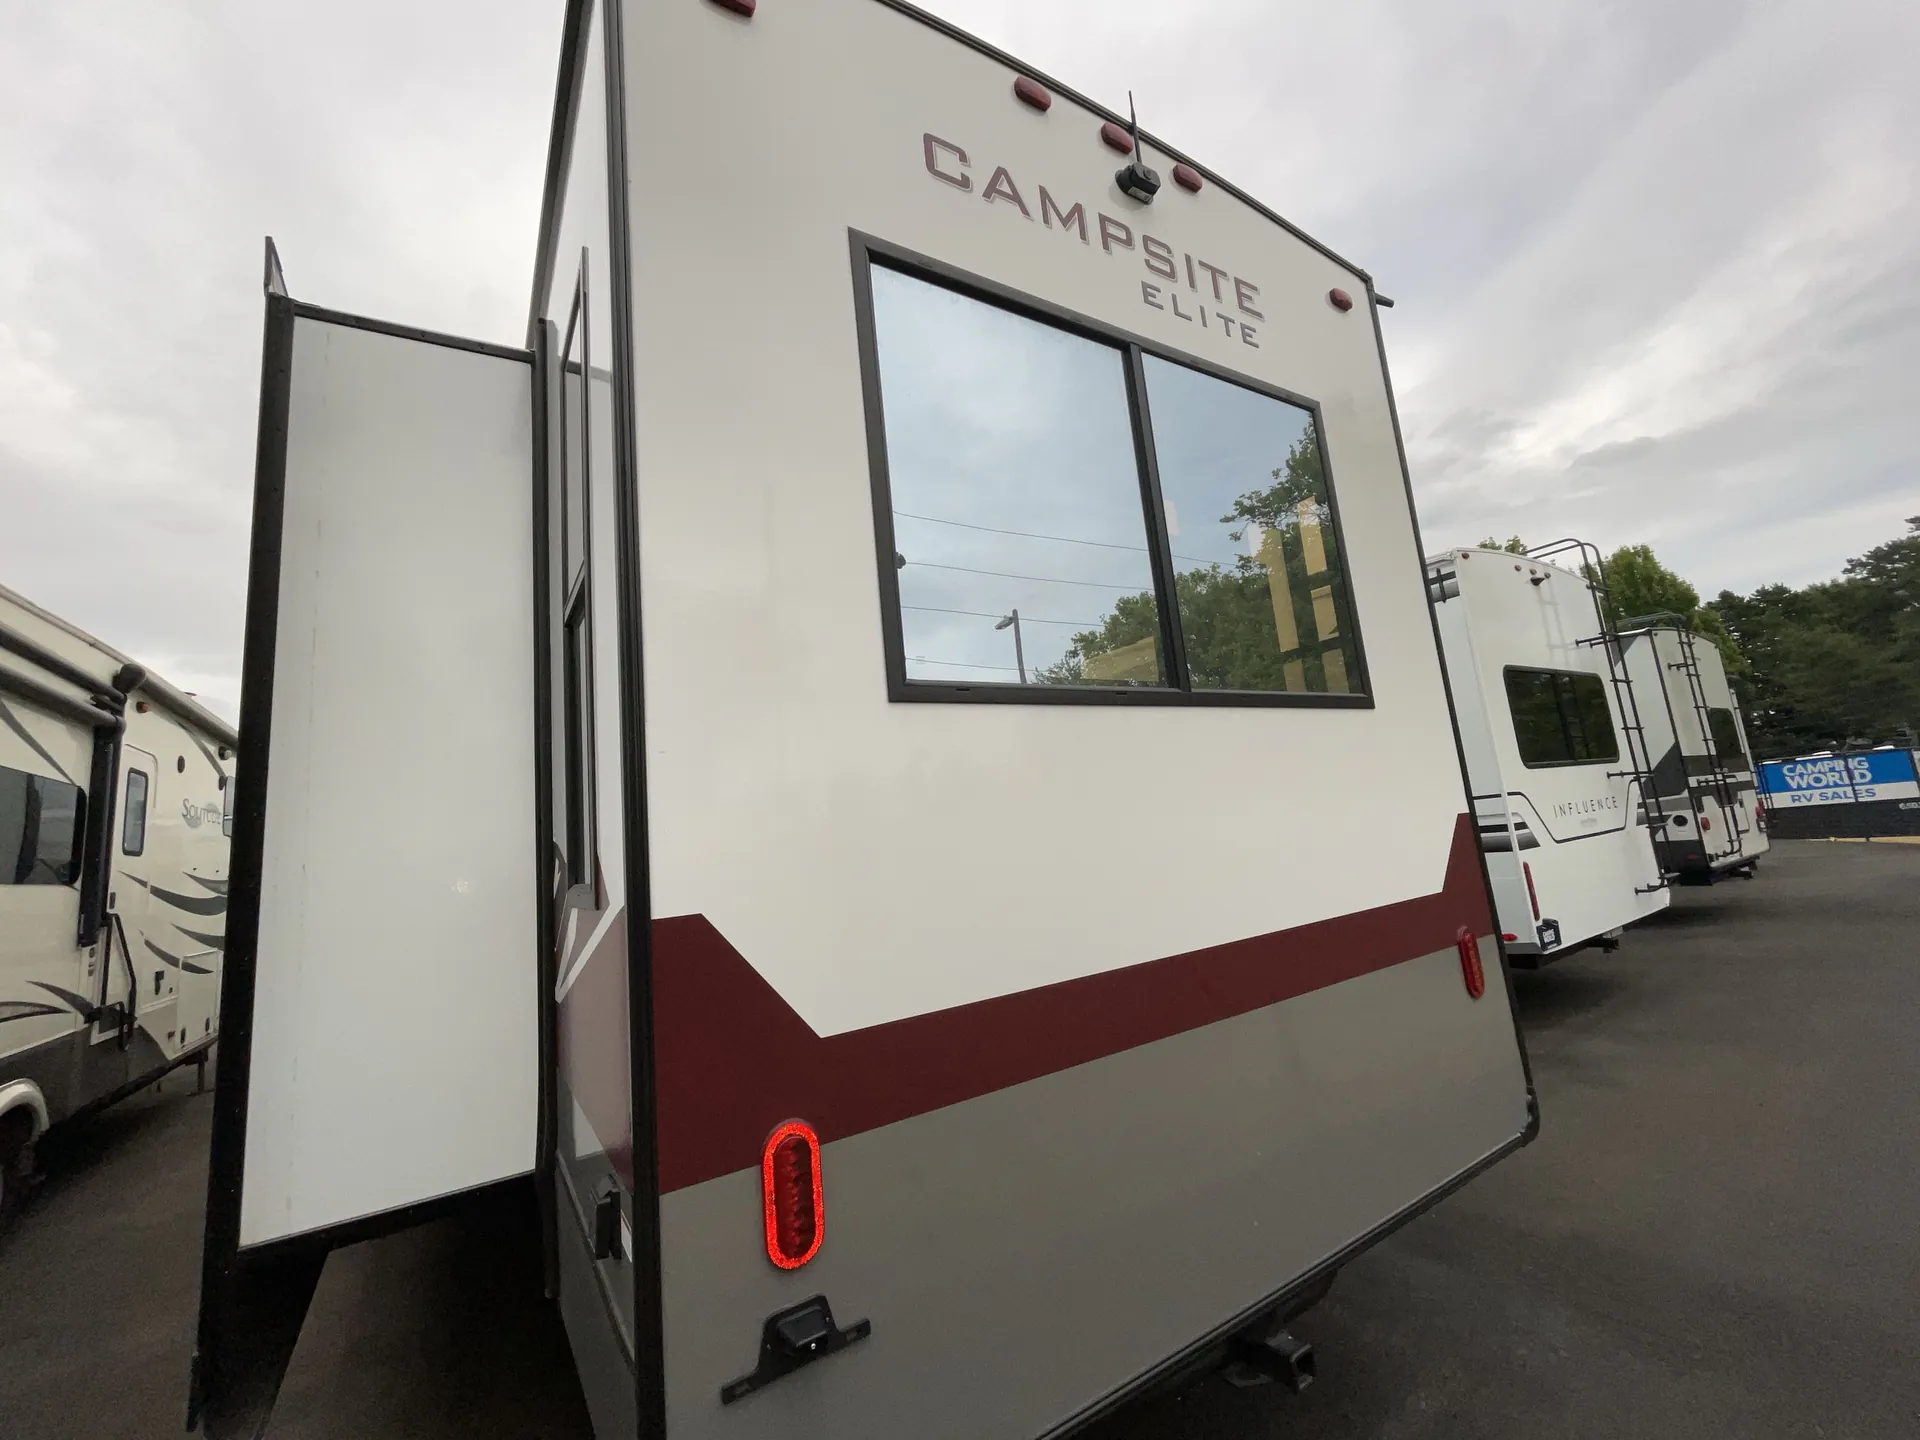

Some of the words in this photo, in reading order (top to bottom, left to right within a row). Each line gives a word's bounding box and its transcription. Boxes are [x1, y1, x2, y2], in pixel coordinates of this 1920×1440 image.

[923, 132, 1265, 321] CAMPSITE
[1141, 280, 1260, 349] ELITE
[1782, 757, 1869, 776] CAMPING
[1784, 769, 1873, 789] WORLD
[1790, 793, 1813, 804] RV
[1819, 788, 1877, 801] SALES
[1552, 796, 1618, 818] INFLUENCE
